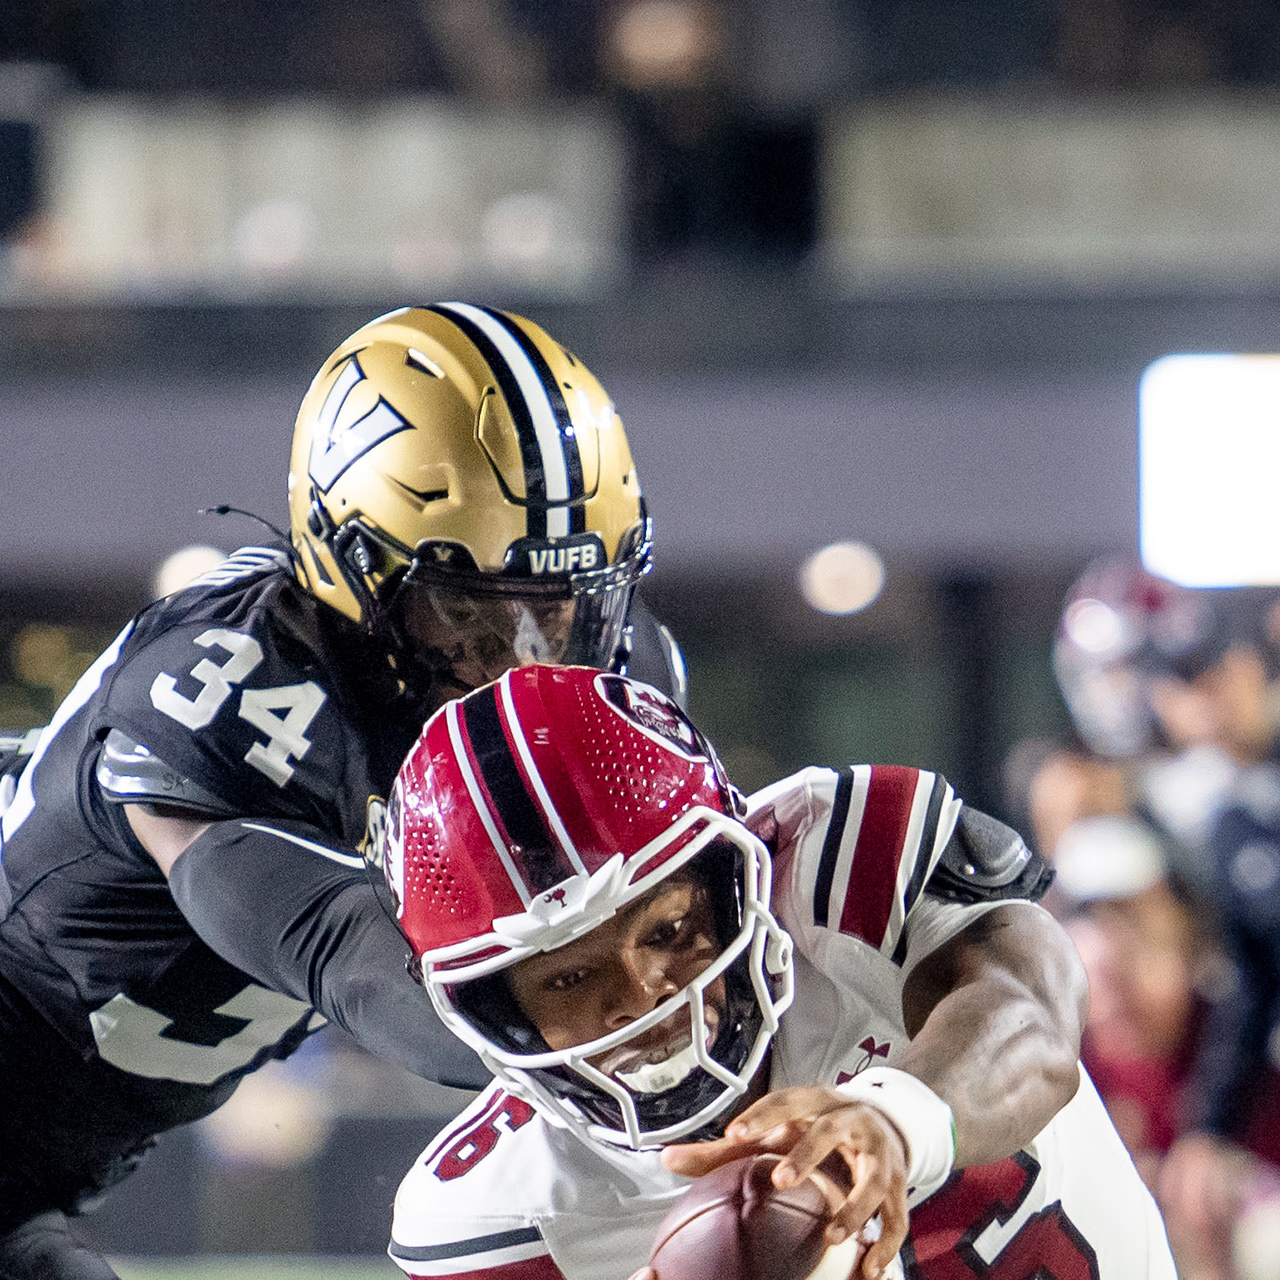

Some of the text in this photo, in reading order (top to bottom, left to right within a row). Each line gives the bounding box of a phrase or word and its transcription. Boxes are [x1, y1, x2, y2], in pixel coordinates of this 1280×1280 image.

[308, 351, 418, 496] V
[528, 544, 597, 575] VUFB
[150, 628, 327, 788] 34
[425, 1087, 537, 1182] 16
